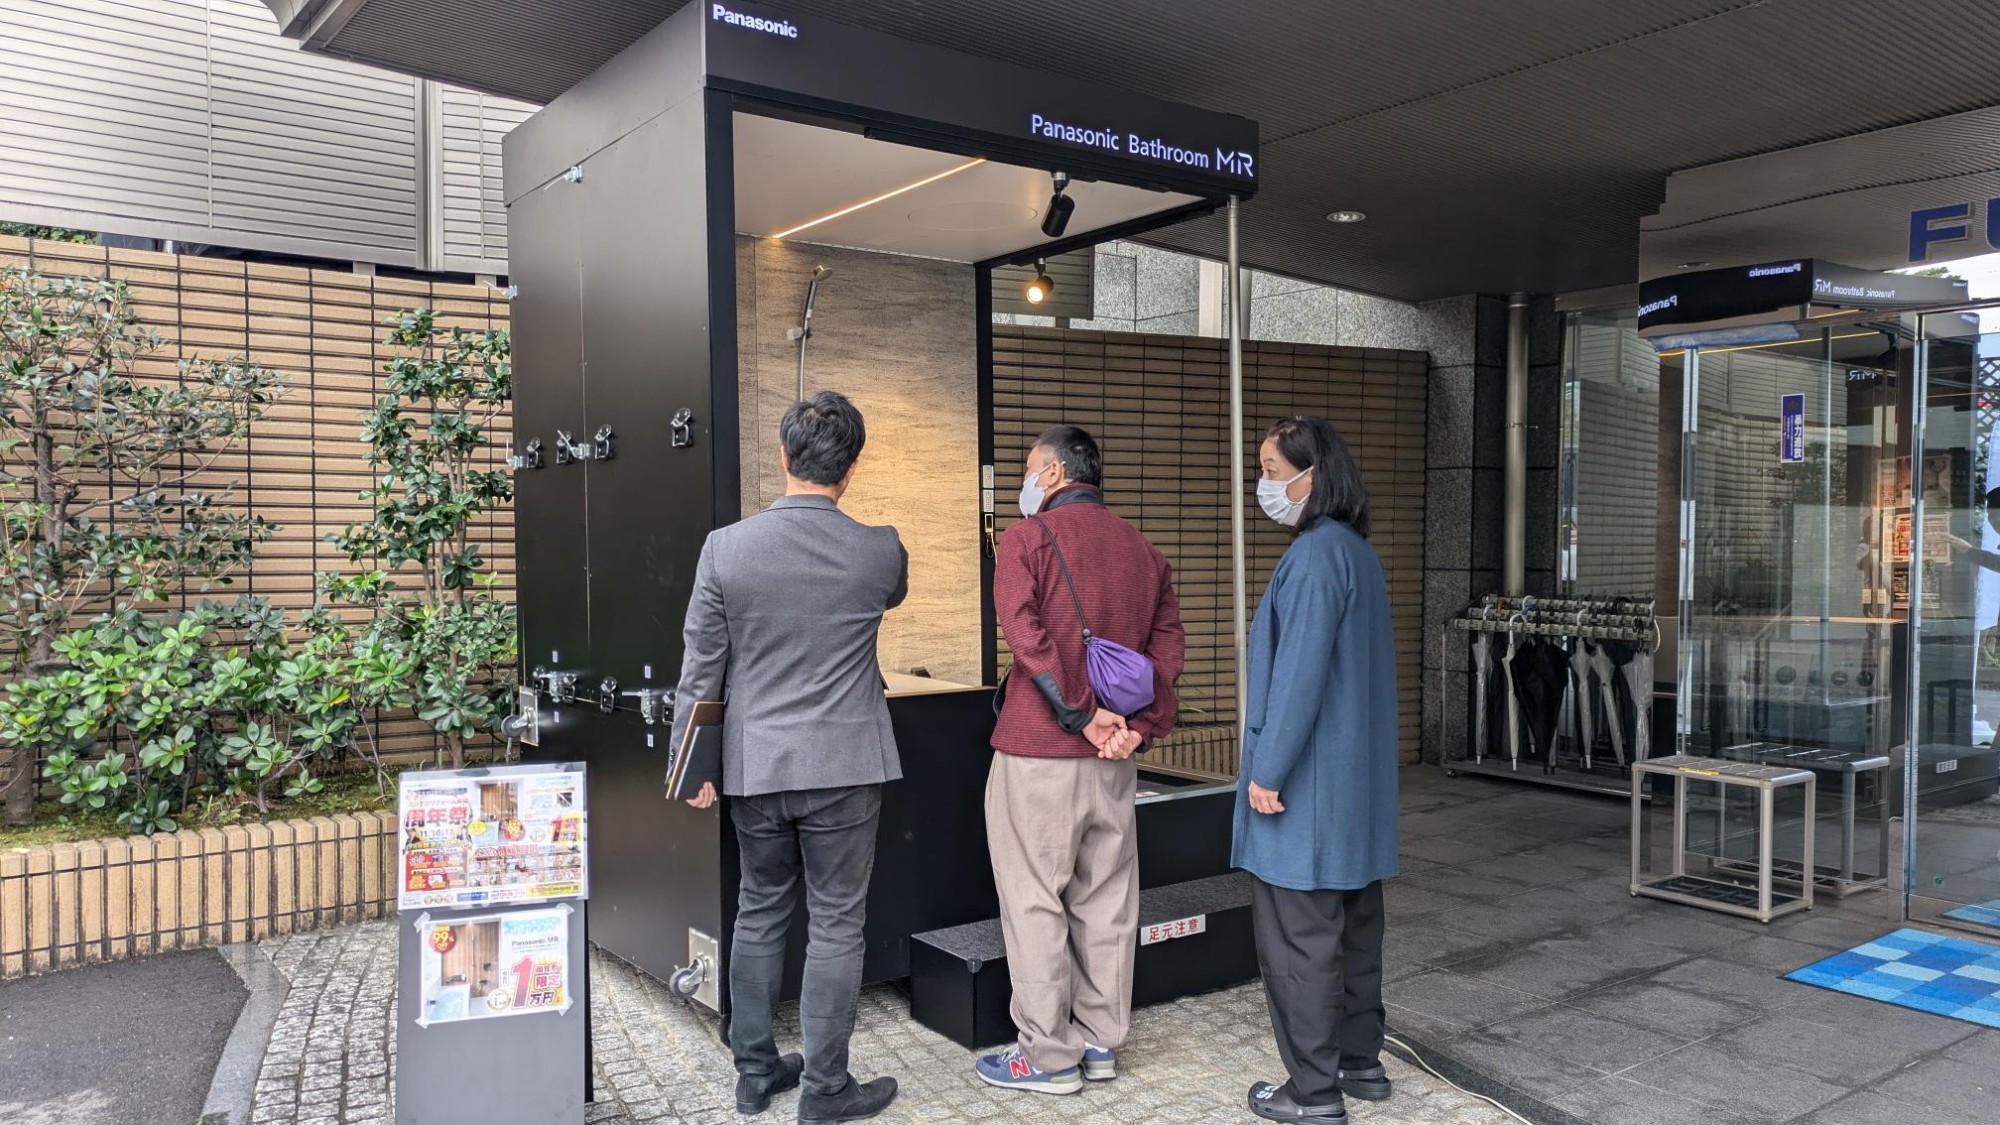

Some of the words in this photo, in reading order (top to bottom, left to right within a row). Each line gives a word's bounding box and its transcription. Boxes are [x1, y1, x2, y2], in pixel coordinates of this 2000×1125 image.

[712, 3, 798, 39] Panasonic
[1031, 113, 1120, 151] Panasonic
[1128, 134, 1209, 169] Bathroom
[1908, 201, 2000, 263] F
[1149, 918, 1199, 942] 足元注意
[511, 955, 535, 1009] 1
[536, 975, 560, 989] 限定
[530, 991, 555, 1006] 万円
[1009, 1056, 1032, 1079] N
